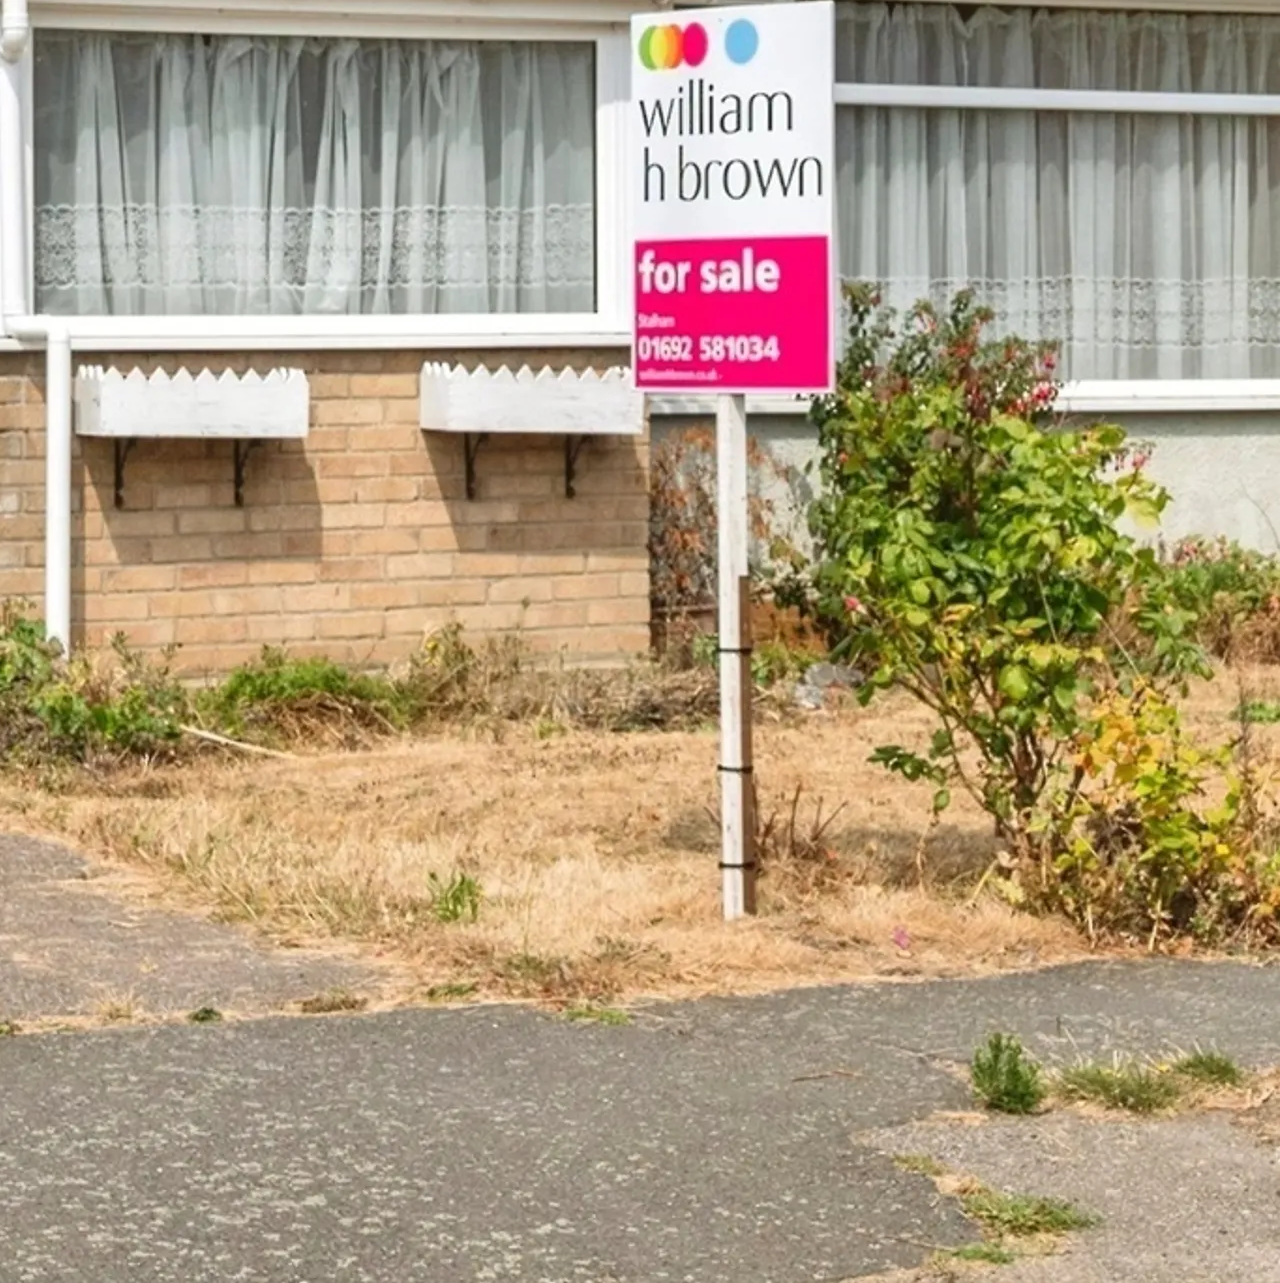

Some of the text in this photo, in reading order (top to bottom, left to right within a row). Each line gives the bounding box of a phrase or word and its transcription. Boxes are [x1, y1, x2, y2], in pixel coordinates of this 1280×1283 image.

[639, 78, 793, 137] william
[643, 144, 823, 202] h brown
[638, 246, 781, 294] for sale
[638, 334, 781, 363] 01692 581034
